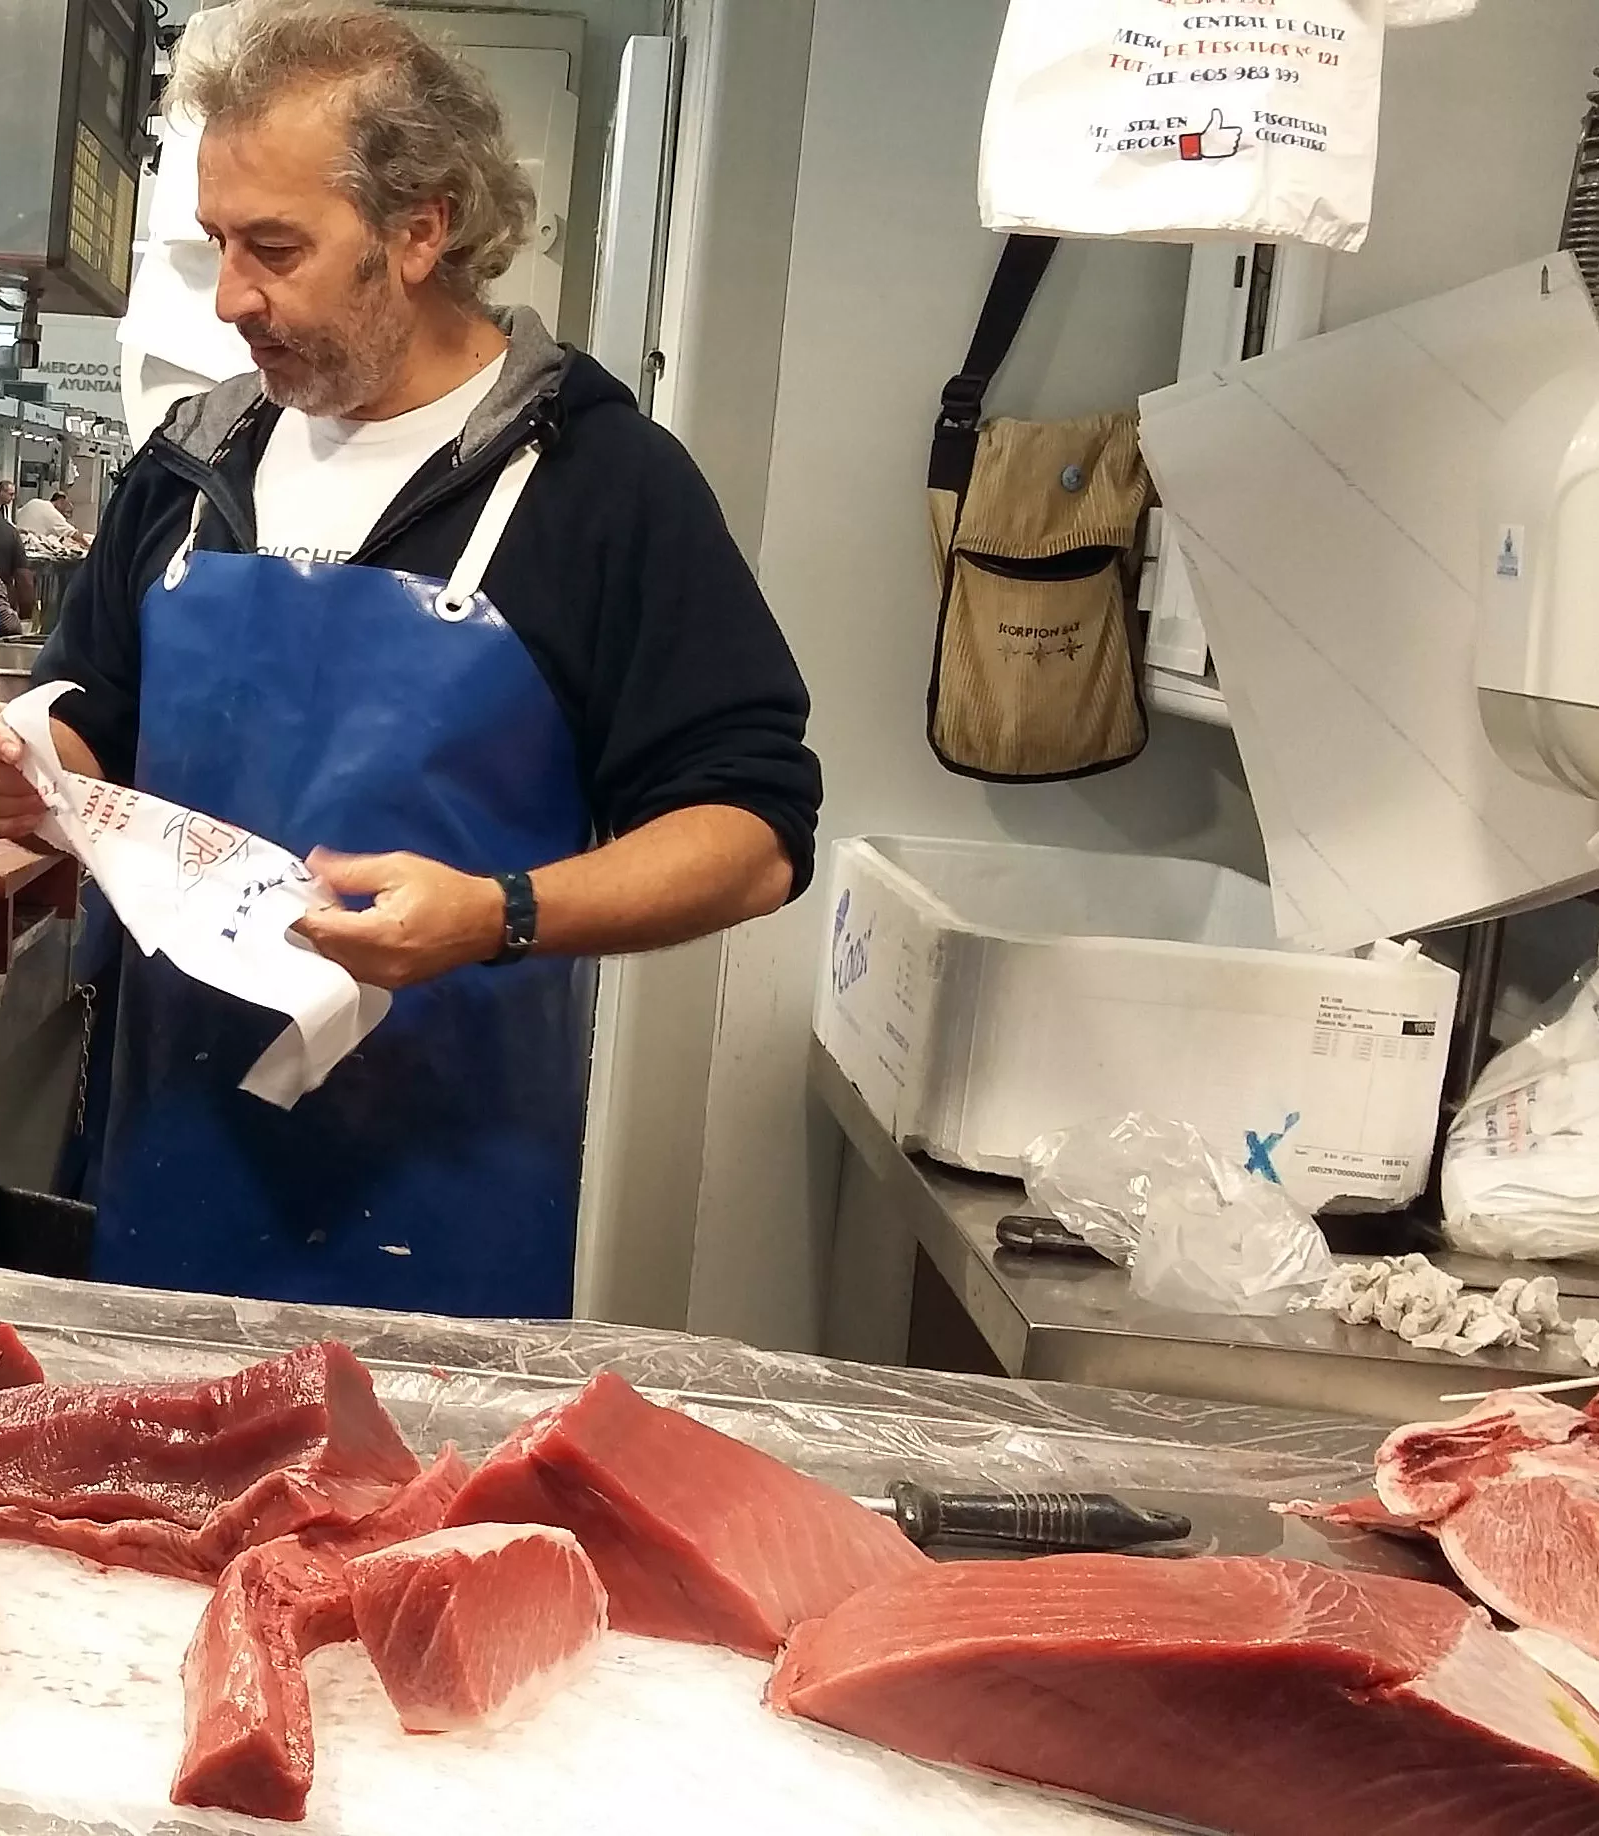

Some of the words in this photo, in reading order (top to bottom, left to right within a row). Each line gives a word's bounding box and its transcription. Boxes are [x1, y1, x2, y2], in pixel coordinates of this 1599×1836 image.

[1183, 15, 1268, 30] CENTRAL
[1276, 18, 1297, 32] DE
[1303, 20, 1346, 42] CADIZ
[1197, 39, 1290, 57] PESCADOS
[1317, 51, 1339, 66] 121
[1190, 67, 1227, 83] 605
[1235, 65, 1270, 81] 983
[1275, 66, 1300, 84] 399
[38, 361, 109, 376] MERCADO
[998, 622, 1060, 638] SCORPION
